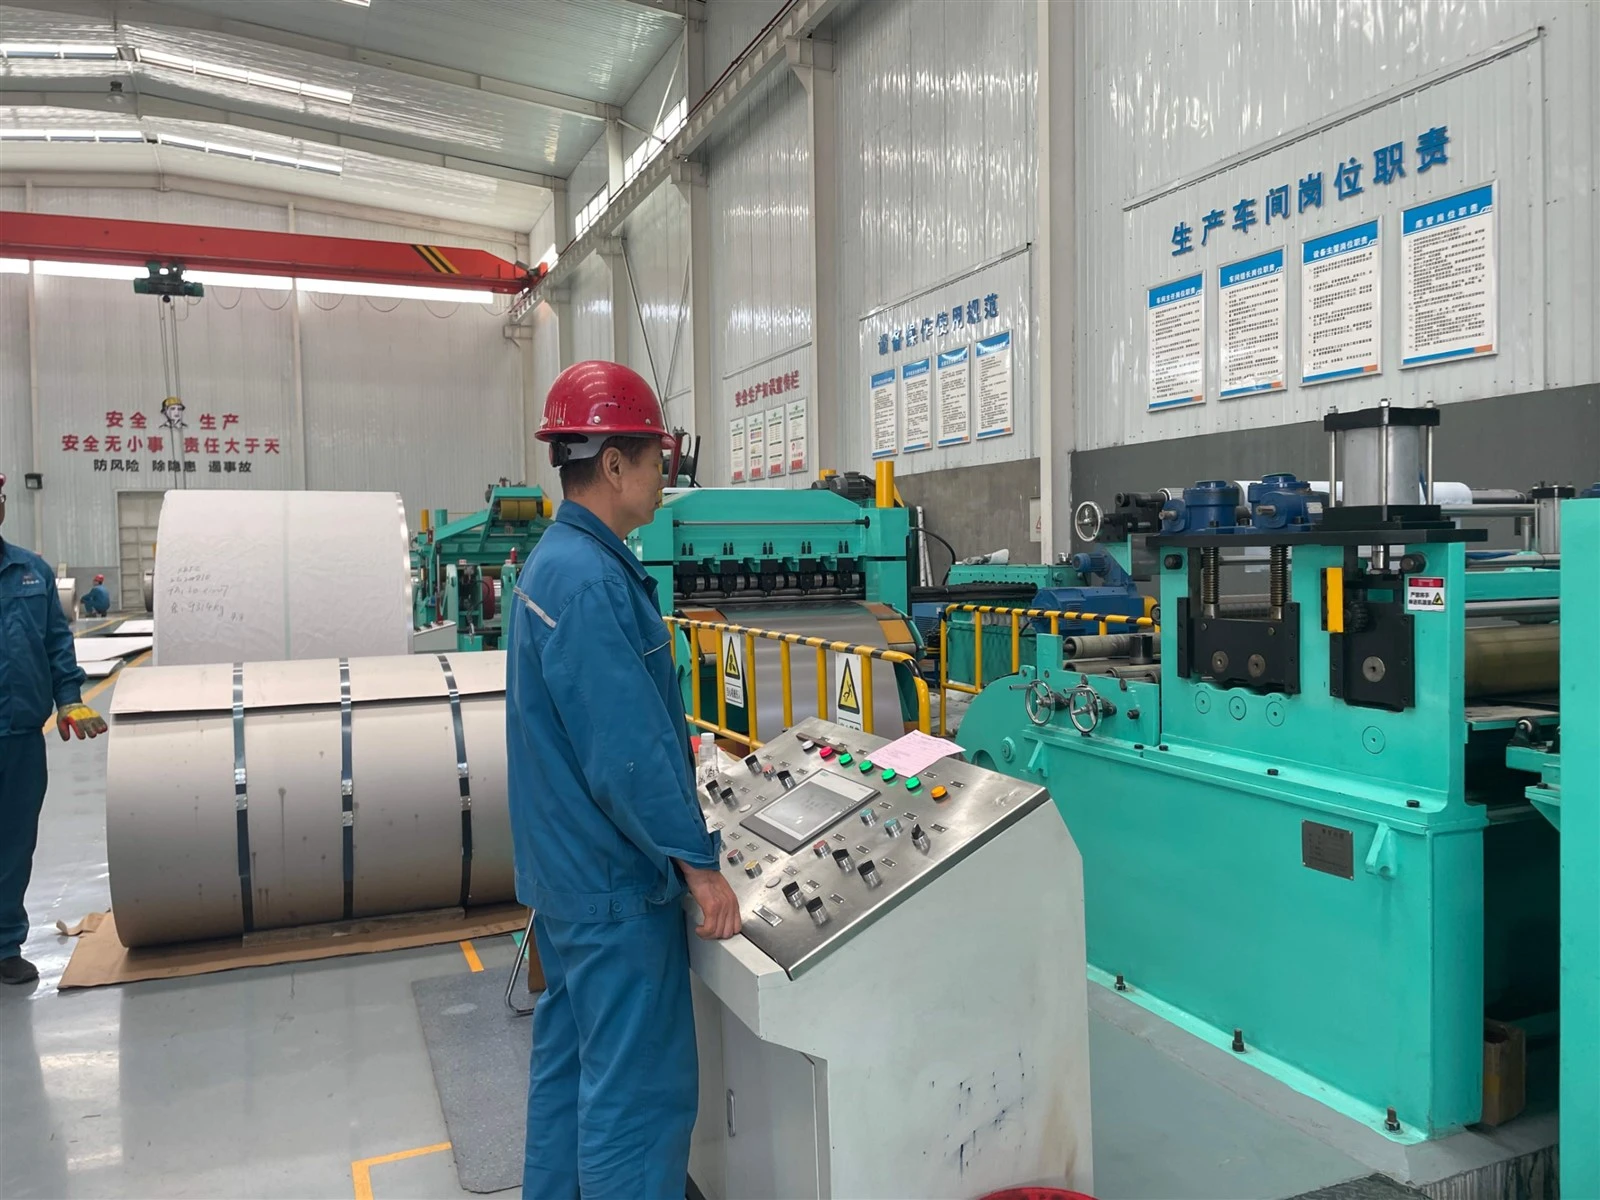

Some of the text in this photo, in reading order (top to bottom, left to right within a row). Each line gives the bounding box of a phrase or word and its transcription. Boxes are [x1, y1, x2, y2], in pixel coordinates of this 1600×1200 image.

[1170, 125, 1451, 258] 生产车间岗位职责
[1312, 235, 1368, 259] 设备主管岗位职责
[878, 293, 1000, 356] 设备操作使用规范
[105, 410, 240, 431] 安全 生产
[61, 434, 280, 455] 安全无小事 责任大于天
[93, 459, 252, 474] 防风险 除隐患 遏事故
